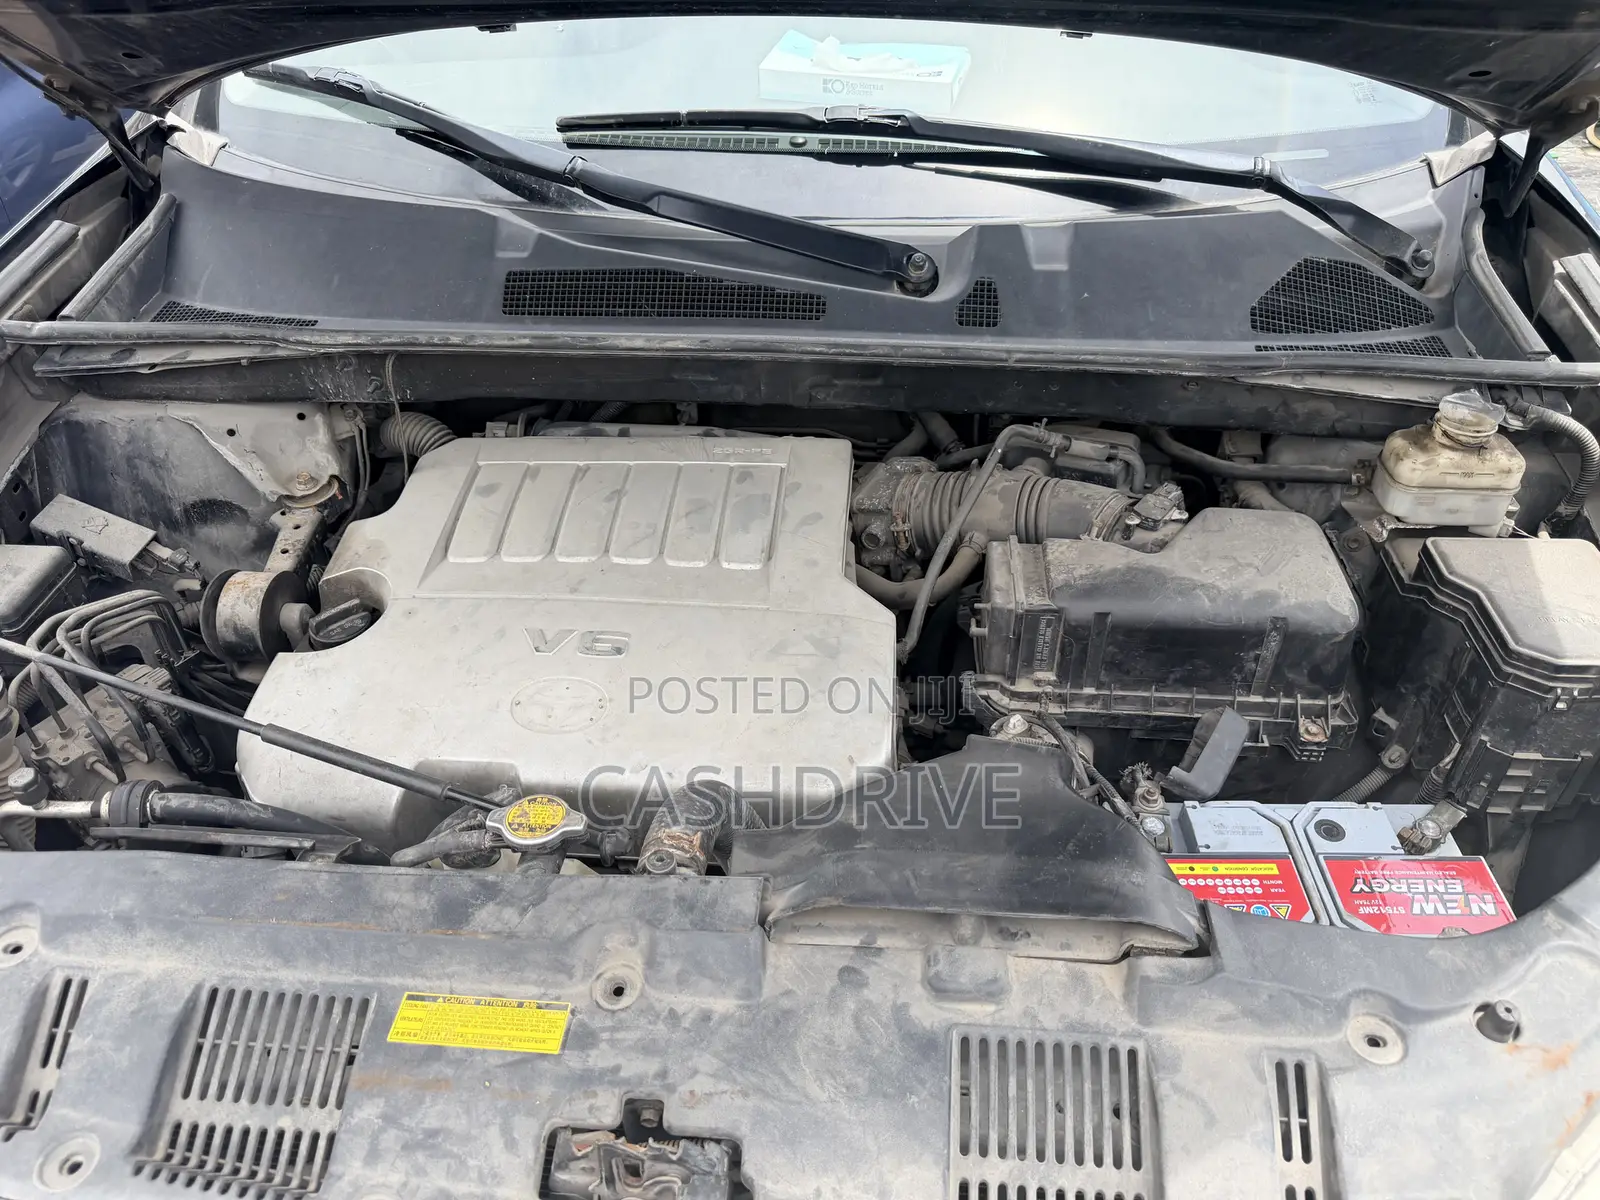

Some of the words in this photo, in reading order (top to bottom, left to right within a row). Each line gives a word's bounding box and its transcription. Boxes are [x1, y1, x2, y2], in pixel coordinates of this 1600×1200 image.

[522, 628, 632, 659] V6
[1350, 877, 1465, 894] ENERGY
[1358, 905, 1406, 914] 57512MF
[445, 996, 476, 1005] CAUTION
[479, 999, 519, 1008] ATTENTION
